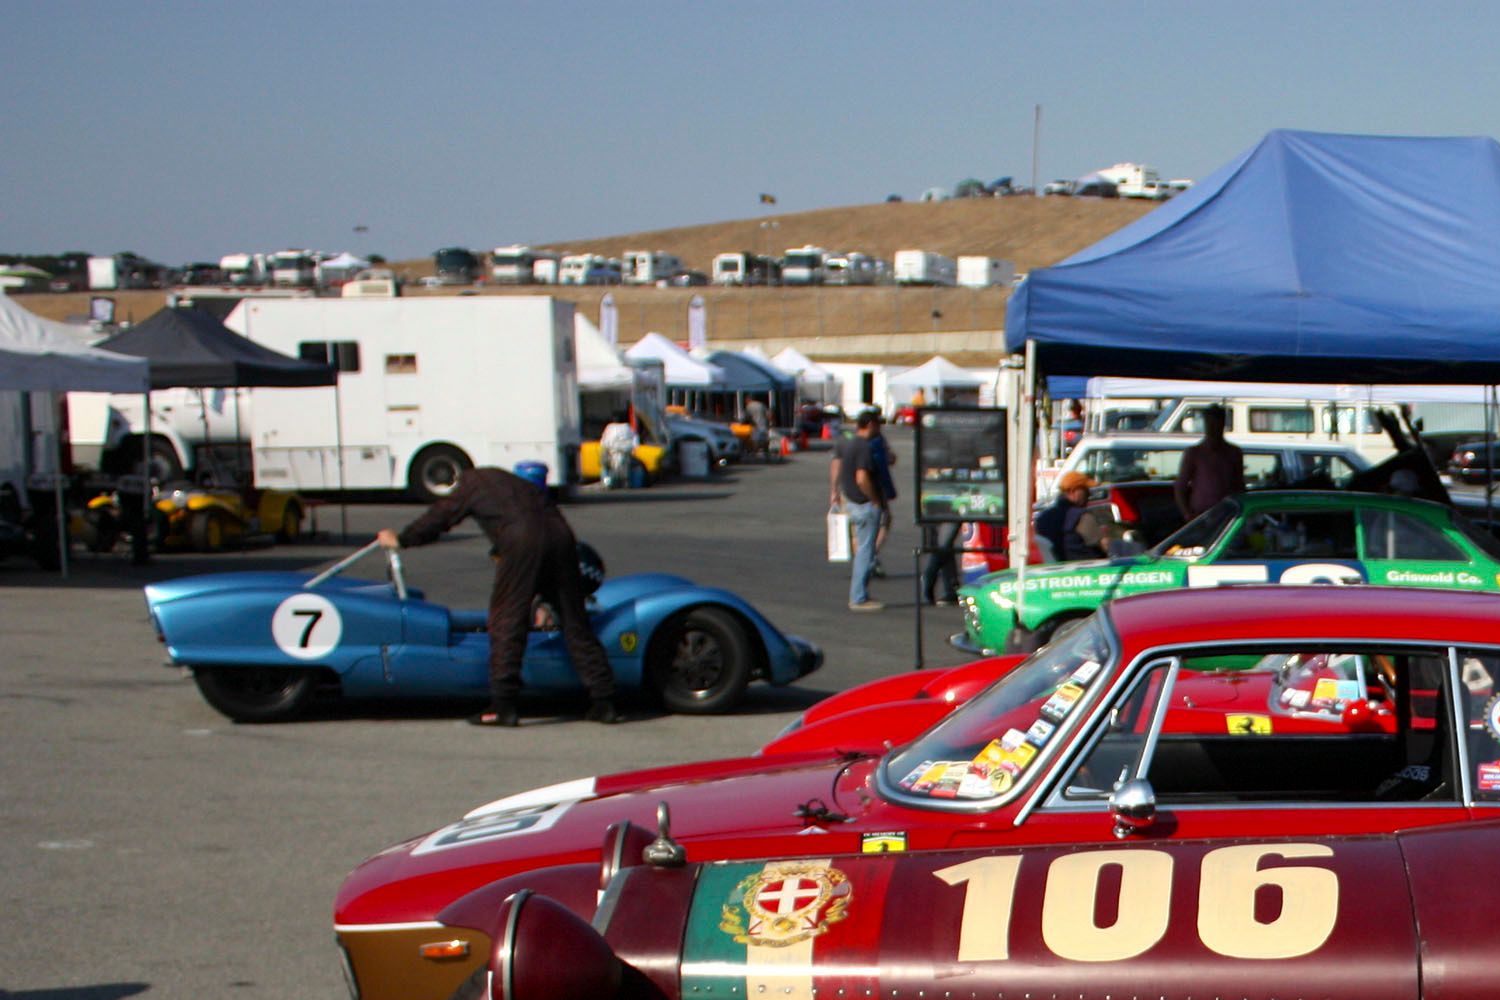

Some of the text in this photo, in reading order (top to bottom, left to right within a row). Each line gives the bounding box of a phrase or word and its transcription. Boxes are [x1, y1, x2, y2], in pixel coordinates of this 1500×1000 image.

[1386, 570, 1482, 585] Griswold Co.
[293, 610, 322, 648] 7
[931, 843, 1339, 962] 106
